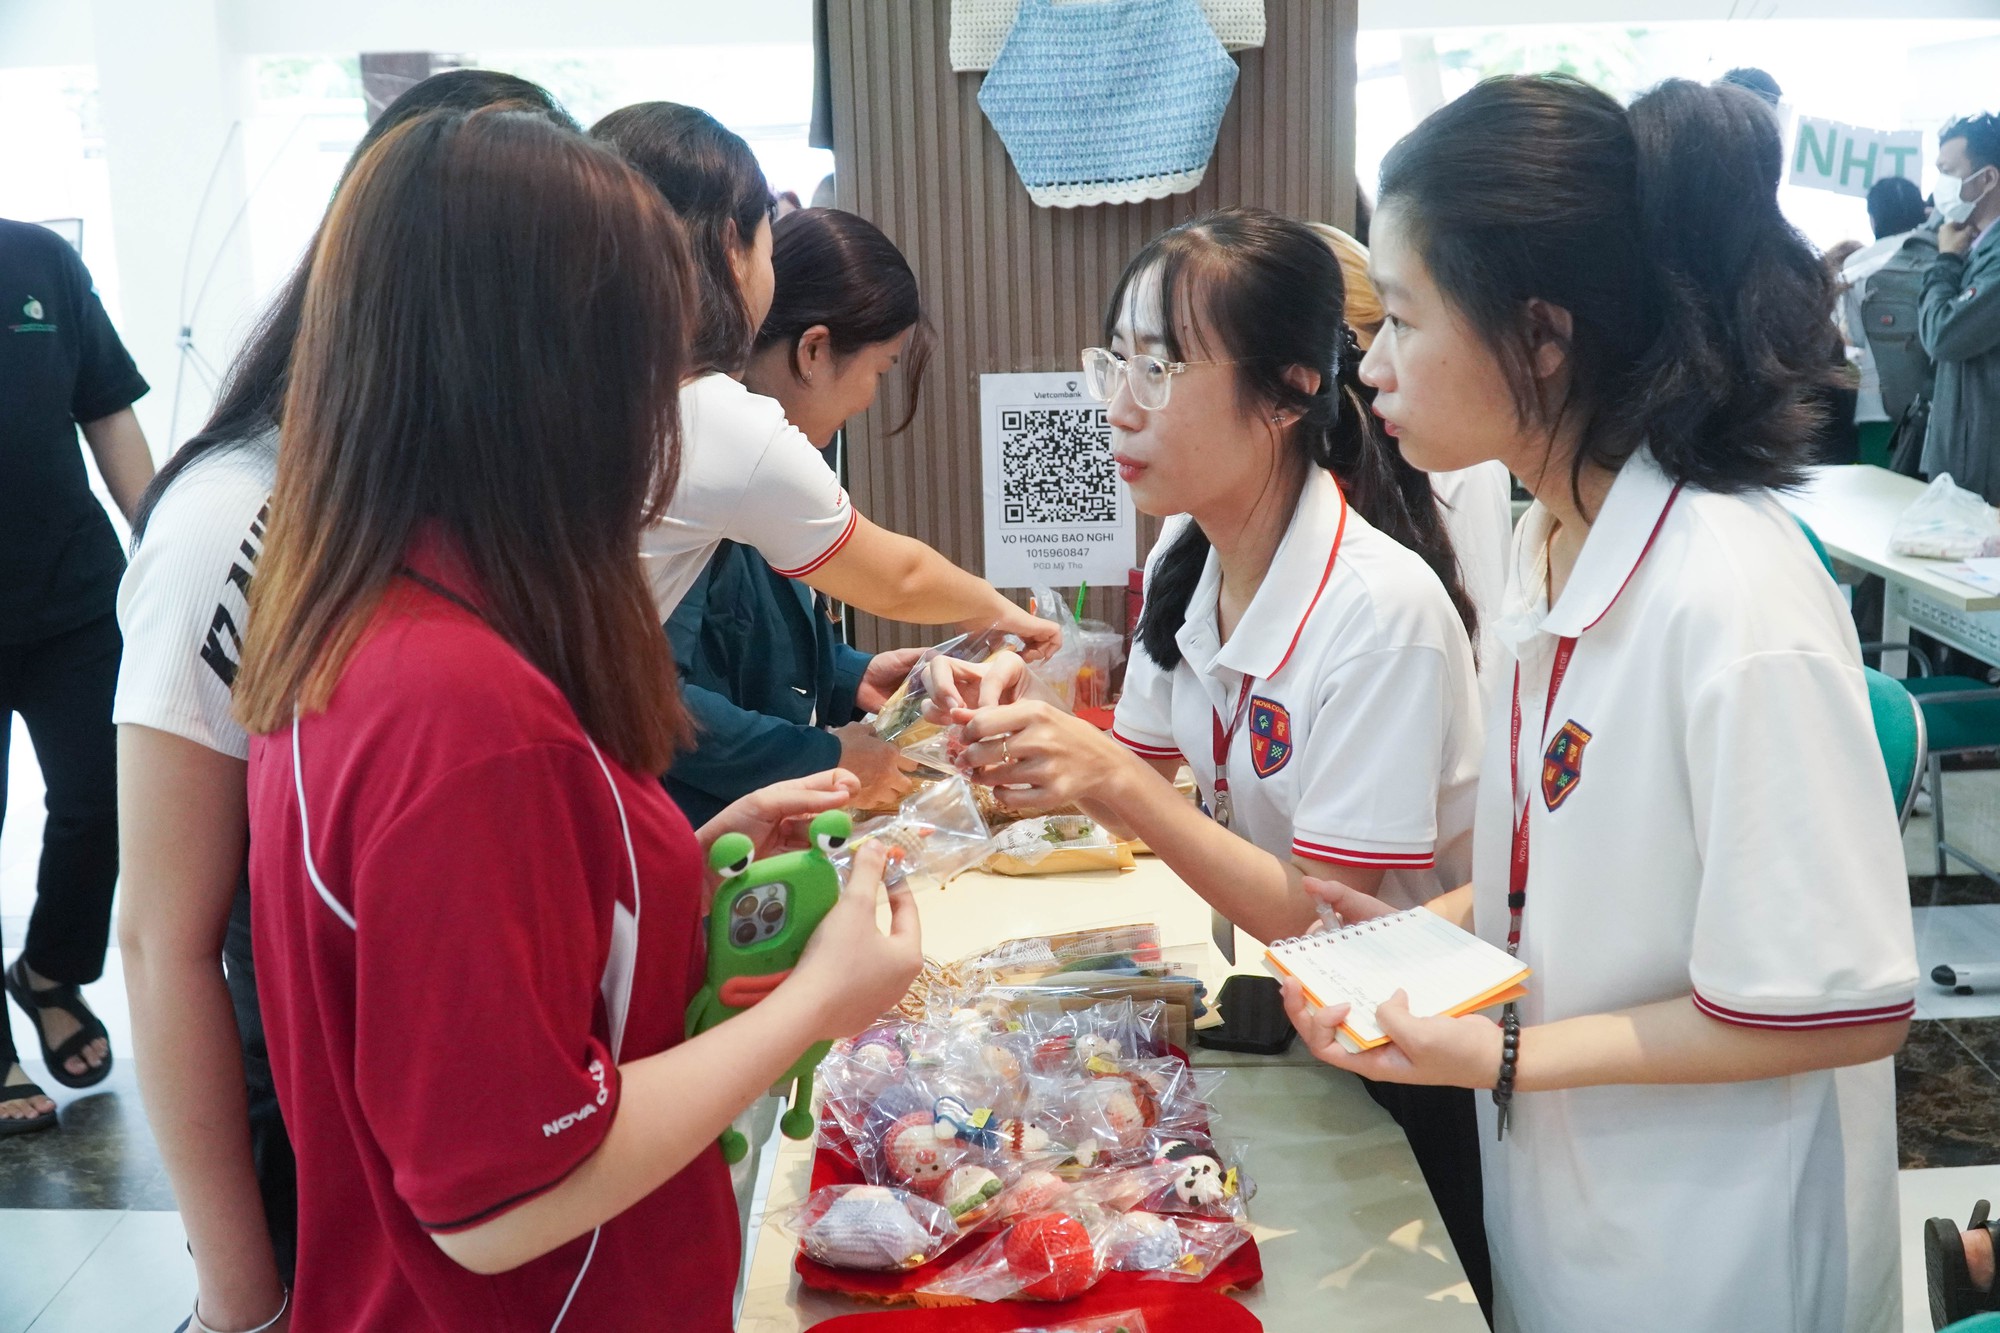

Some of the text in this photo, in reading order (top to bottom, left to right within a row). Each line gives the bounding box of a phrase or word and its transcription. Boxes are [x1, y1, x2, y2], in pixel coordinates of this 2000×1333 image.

[1796, 124, 1918, 190] NHT
[1034, 391, 1082, 399] Vietcombank
[1001, 533, 1114, 544] VO HOANG BAO NGHI
[1026, 548, 1090, 558] 1015960847
[1033, 562, 1051, 570] PGD
[1068, 561, 1083, 569] Tho
[1253, 699, 1271, 709] NOVA
[1518, 840, 1527, 863] NOVA
[542, 1104, 597, 1137] NOVA
